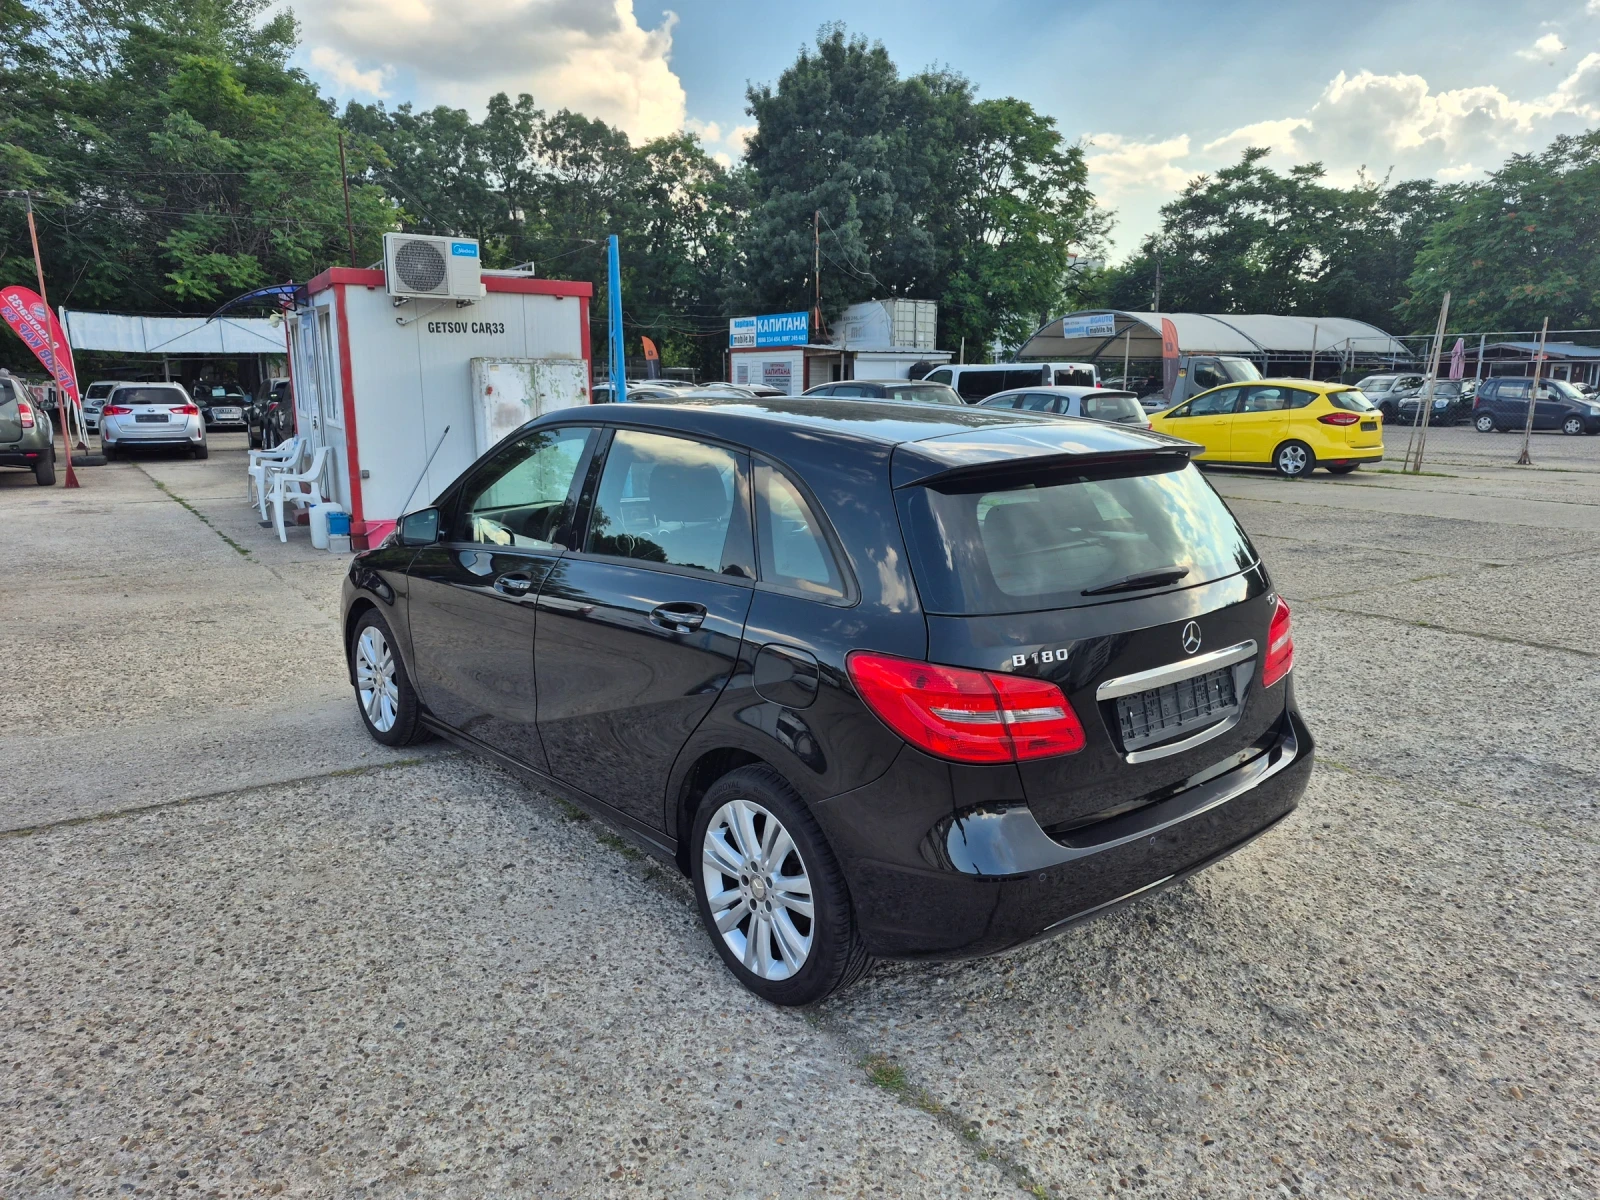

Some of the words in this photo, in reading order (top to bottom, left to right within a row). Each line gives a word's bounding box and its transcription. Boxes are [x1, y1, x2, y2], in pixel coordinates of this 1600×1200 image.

[428, 322, 468, 333] GETSOV
[471, 322, 505, 336] CAR33
[757, 316, 807, 333] КАПИТАНА
[733, 334, 755, 346] mobile.bg
[1012, 654, 1026, 667] B
[1031, 648, 1068, 664] 180
